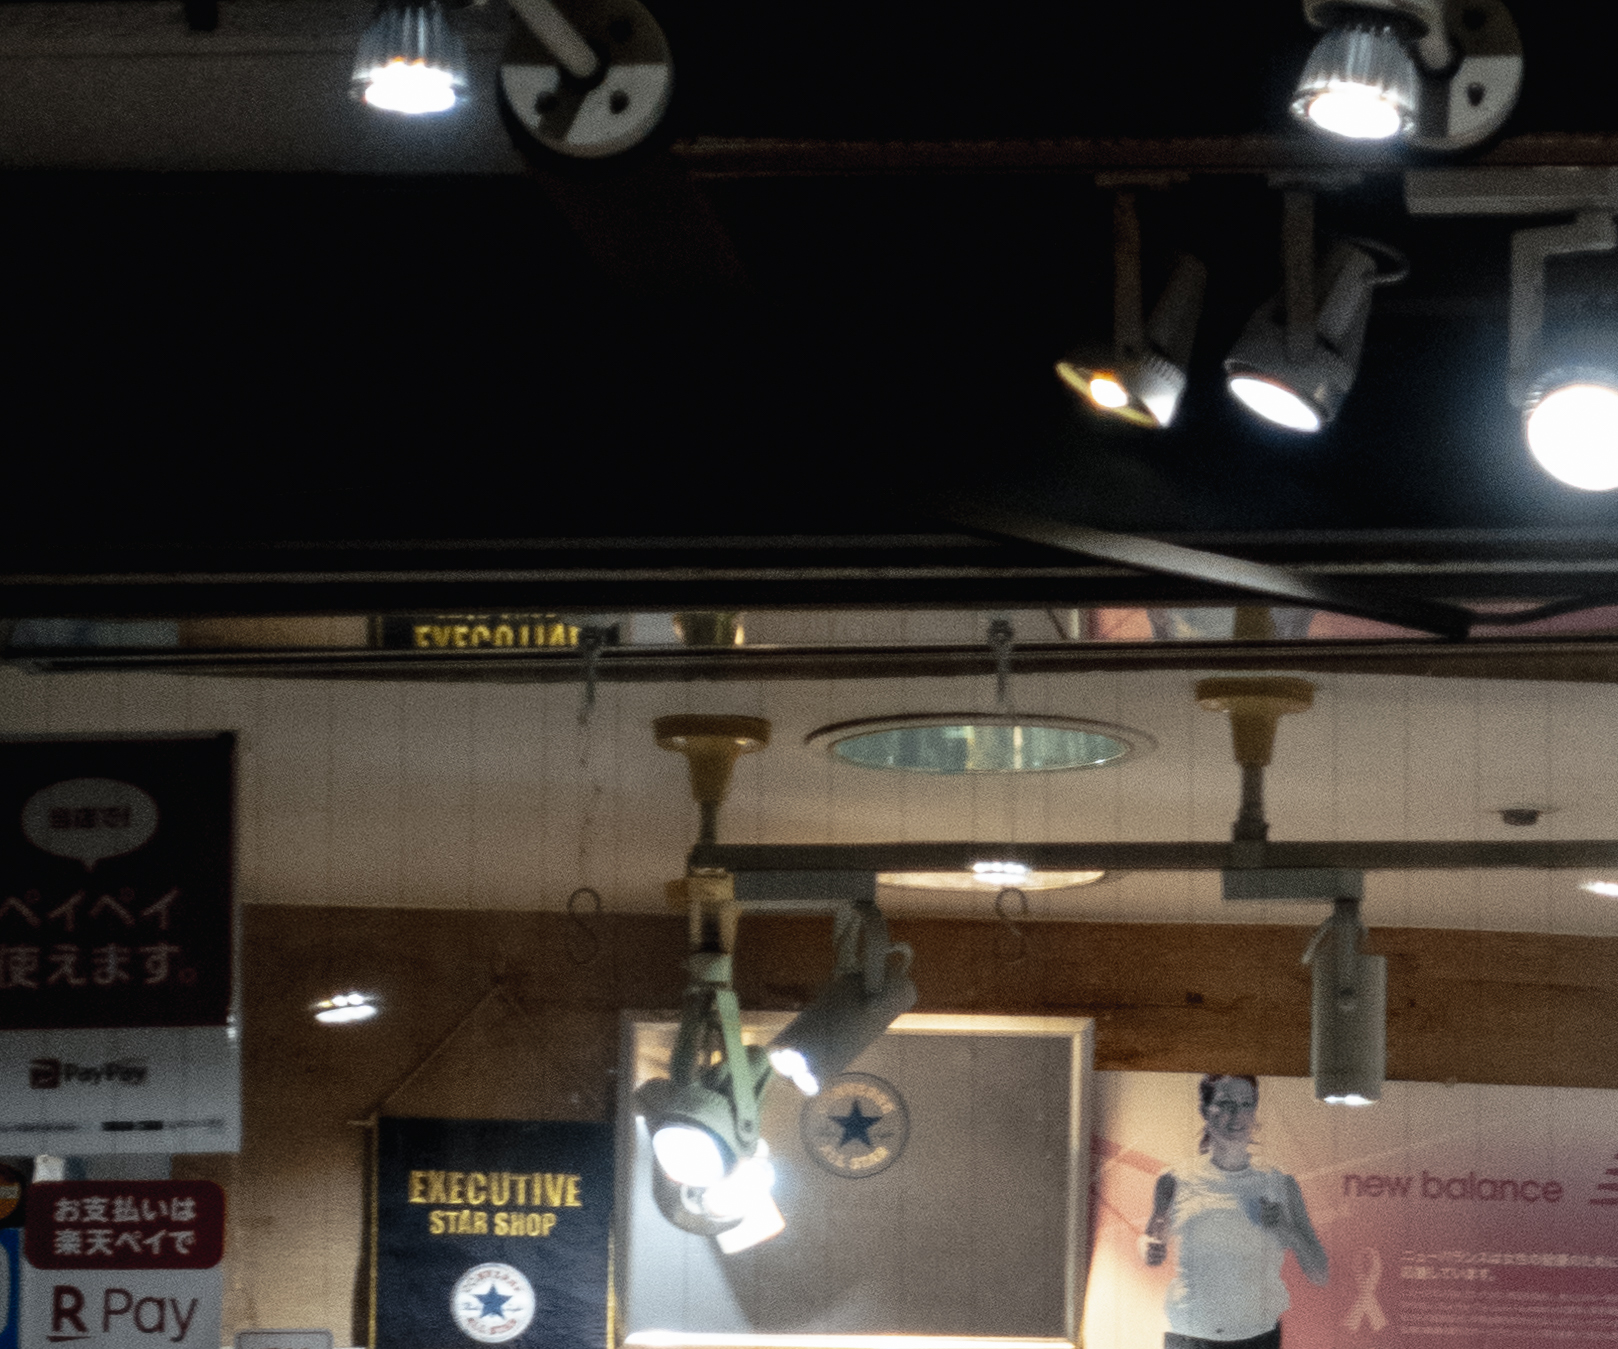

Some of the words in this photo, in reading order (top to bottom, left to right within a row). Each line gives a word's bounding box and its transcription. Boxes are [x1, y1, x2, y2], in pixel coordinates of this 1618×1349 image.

[408, 1170, 582, 1207] EXECUTIVE
[1342, 1173, 1414, 1199] new
[1421, 1170, 1564, 1203] balance
[54, 1196, 196, 1223] お支払いは
[428, 1209, 488, 1235] STAR
[493, 1211, 558, 1237] SHOP
[54, 1229, 196, 1256] 楽天ペイで
[102, 1288, 198, 1343] Pay
